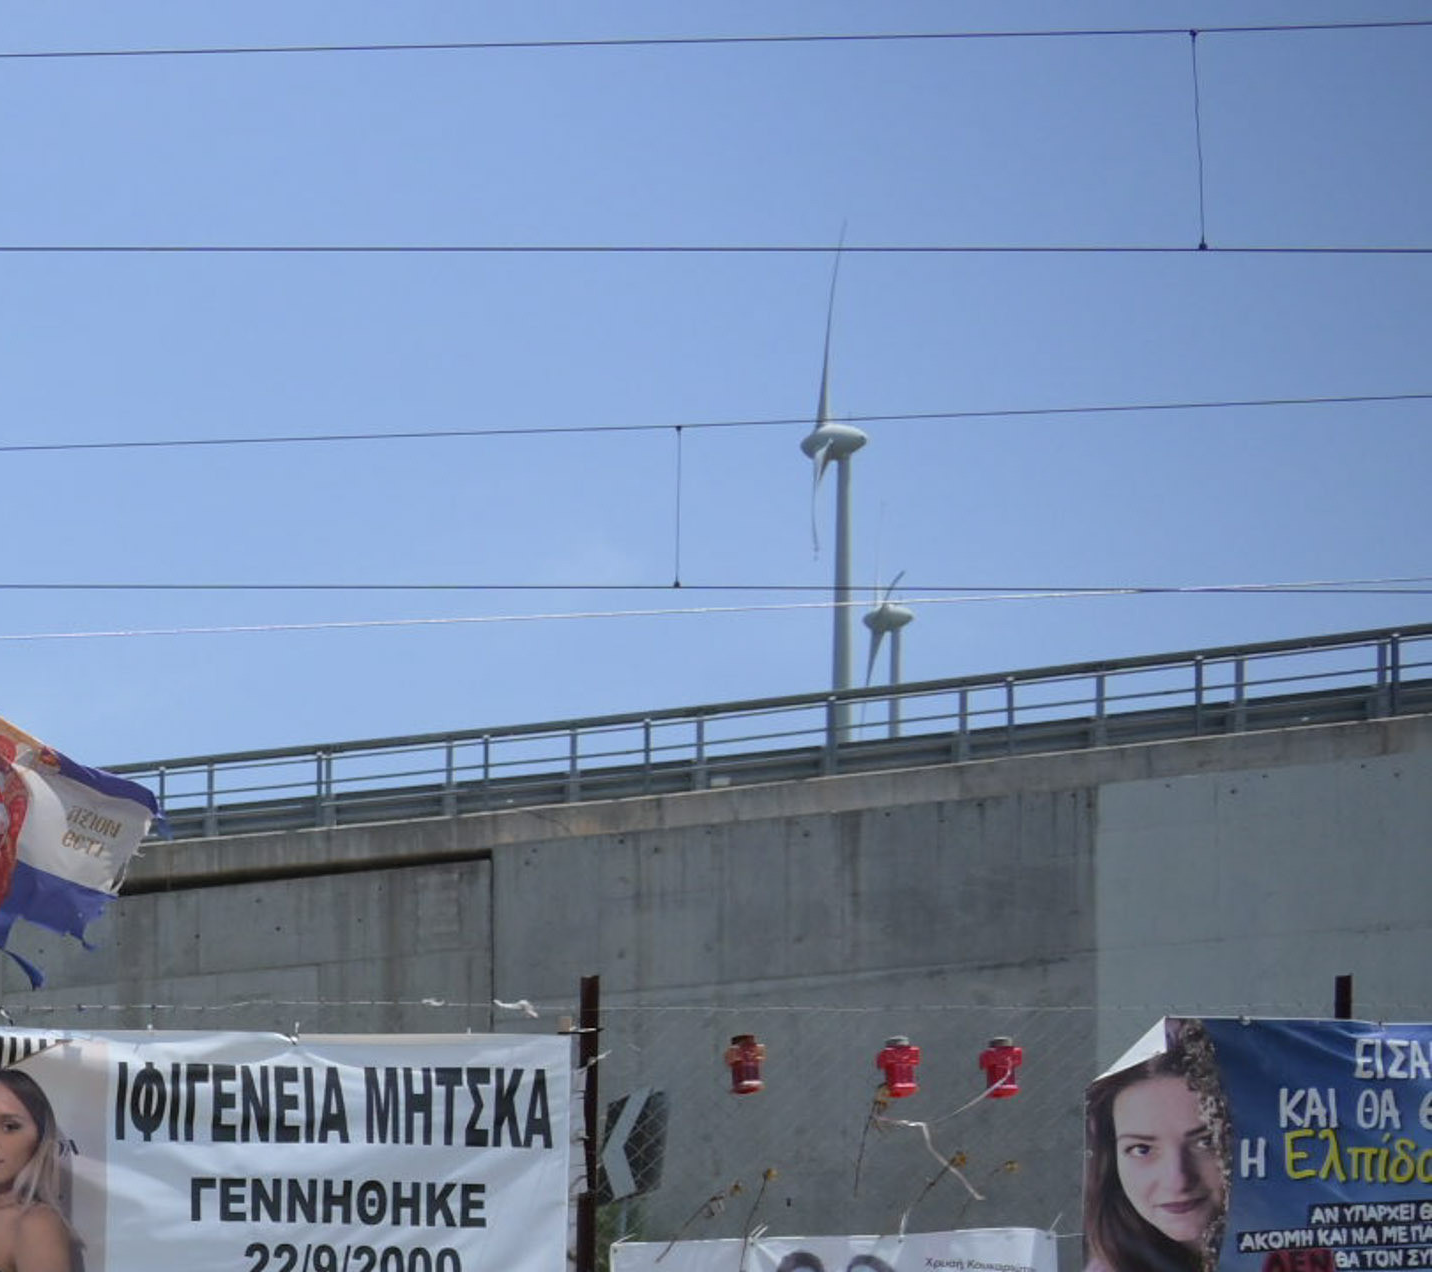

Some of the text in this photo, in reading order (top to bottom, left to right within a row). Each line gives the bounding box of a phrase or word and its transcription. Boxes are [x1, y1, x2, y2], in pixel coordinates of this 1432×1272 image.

[1354, 1038, 1432, 1080] ΕΙΣΑ
[115, 1061, 553, 1149] ΙΦΙΓΕΝΕΙΑ ΜΗΤΣΚΑ
[1278, 1087, 1339, 1129] ΚΑΙ
[1356, 1088, 1401, 1130] ΘΑ
[1240, 1137, 1266, 1178] Η
[190, 1176, 487, 1228] ΓΕΝΝΗΘΗΚΕ
[1311, 1203, 1416, 1225] ΑΝ ΥΠΑΡΧΕΙ
[1239, 1231, 1314, 1251] ΑΚΟΜΗ
[1316, 1228, 1348, 1247] ΚΑΙ
[1352, 1226, 1378, 1245] ΝΑ
[1334, 1250, 1360, 1269] ΘΑ
[1361, 1249, 1404, 1268] ΤΟΝ
